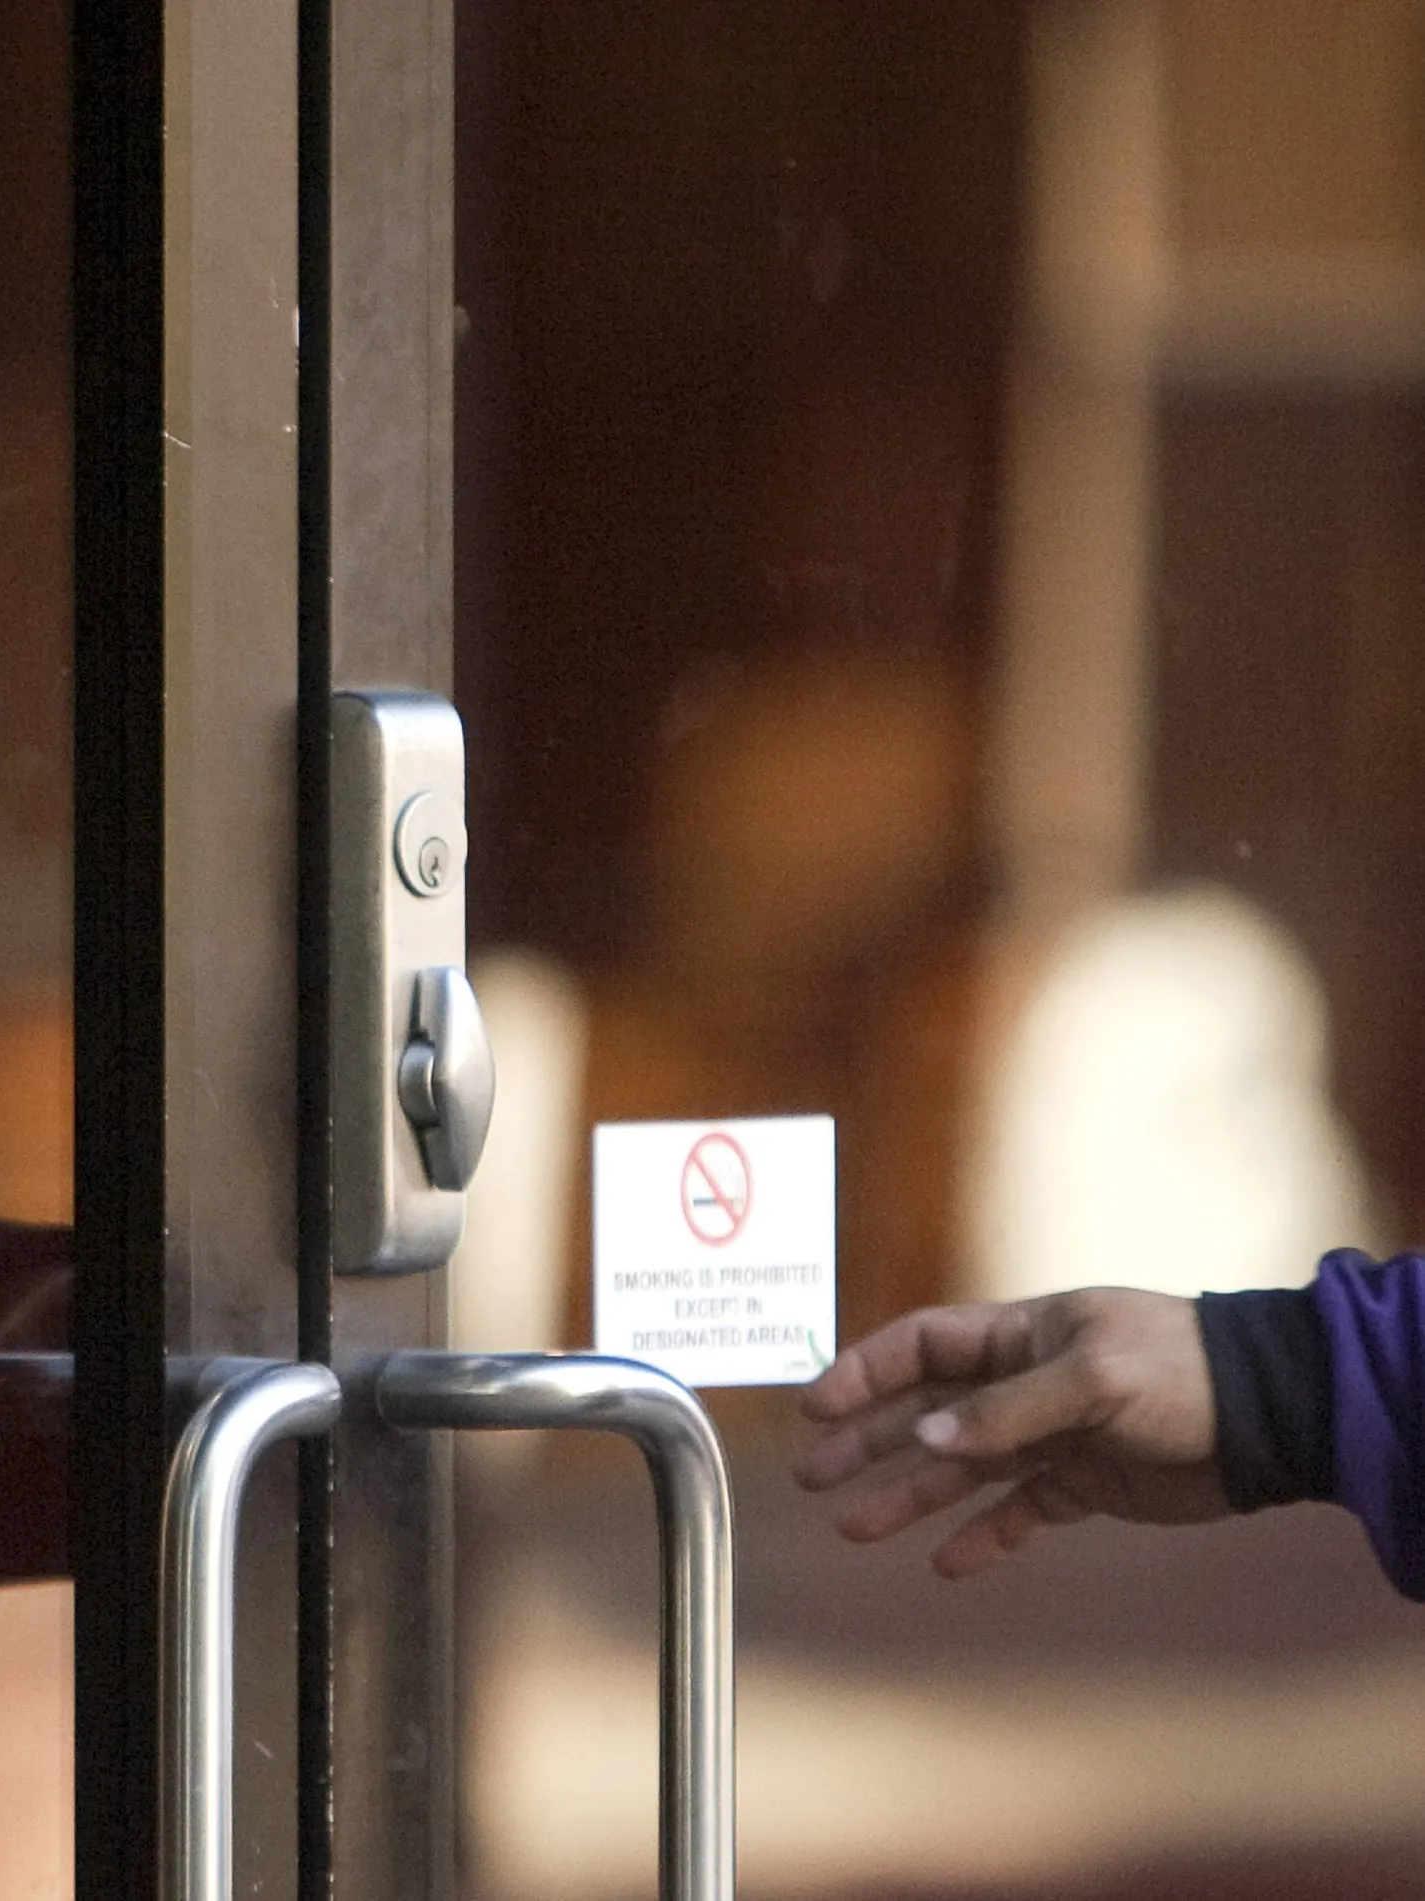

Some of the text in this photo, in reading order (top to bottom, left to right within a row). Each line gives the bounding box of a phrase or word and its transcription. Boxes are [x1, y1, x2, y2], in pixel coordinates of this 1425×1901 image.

[614, 1264, 823, 1292] SMOKING IS PROHIBITED
[675, 1296, 763, 1319] EXCEPT IN
[632, 1325, 806, 1351] DESIGNATED AREAS
